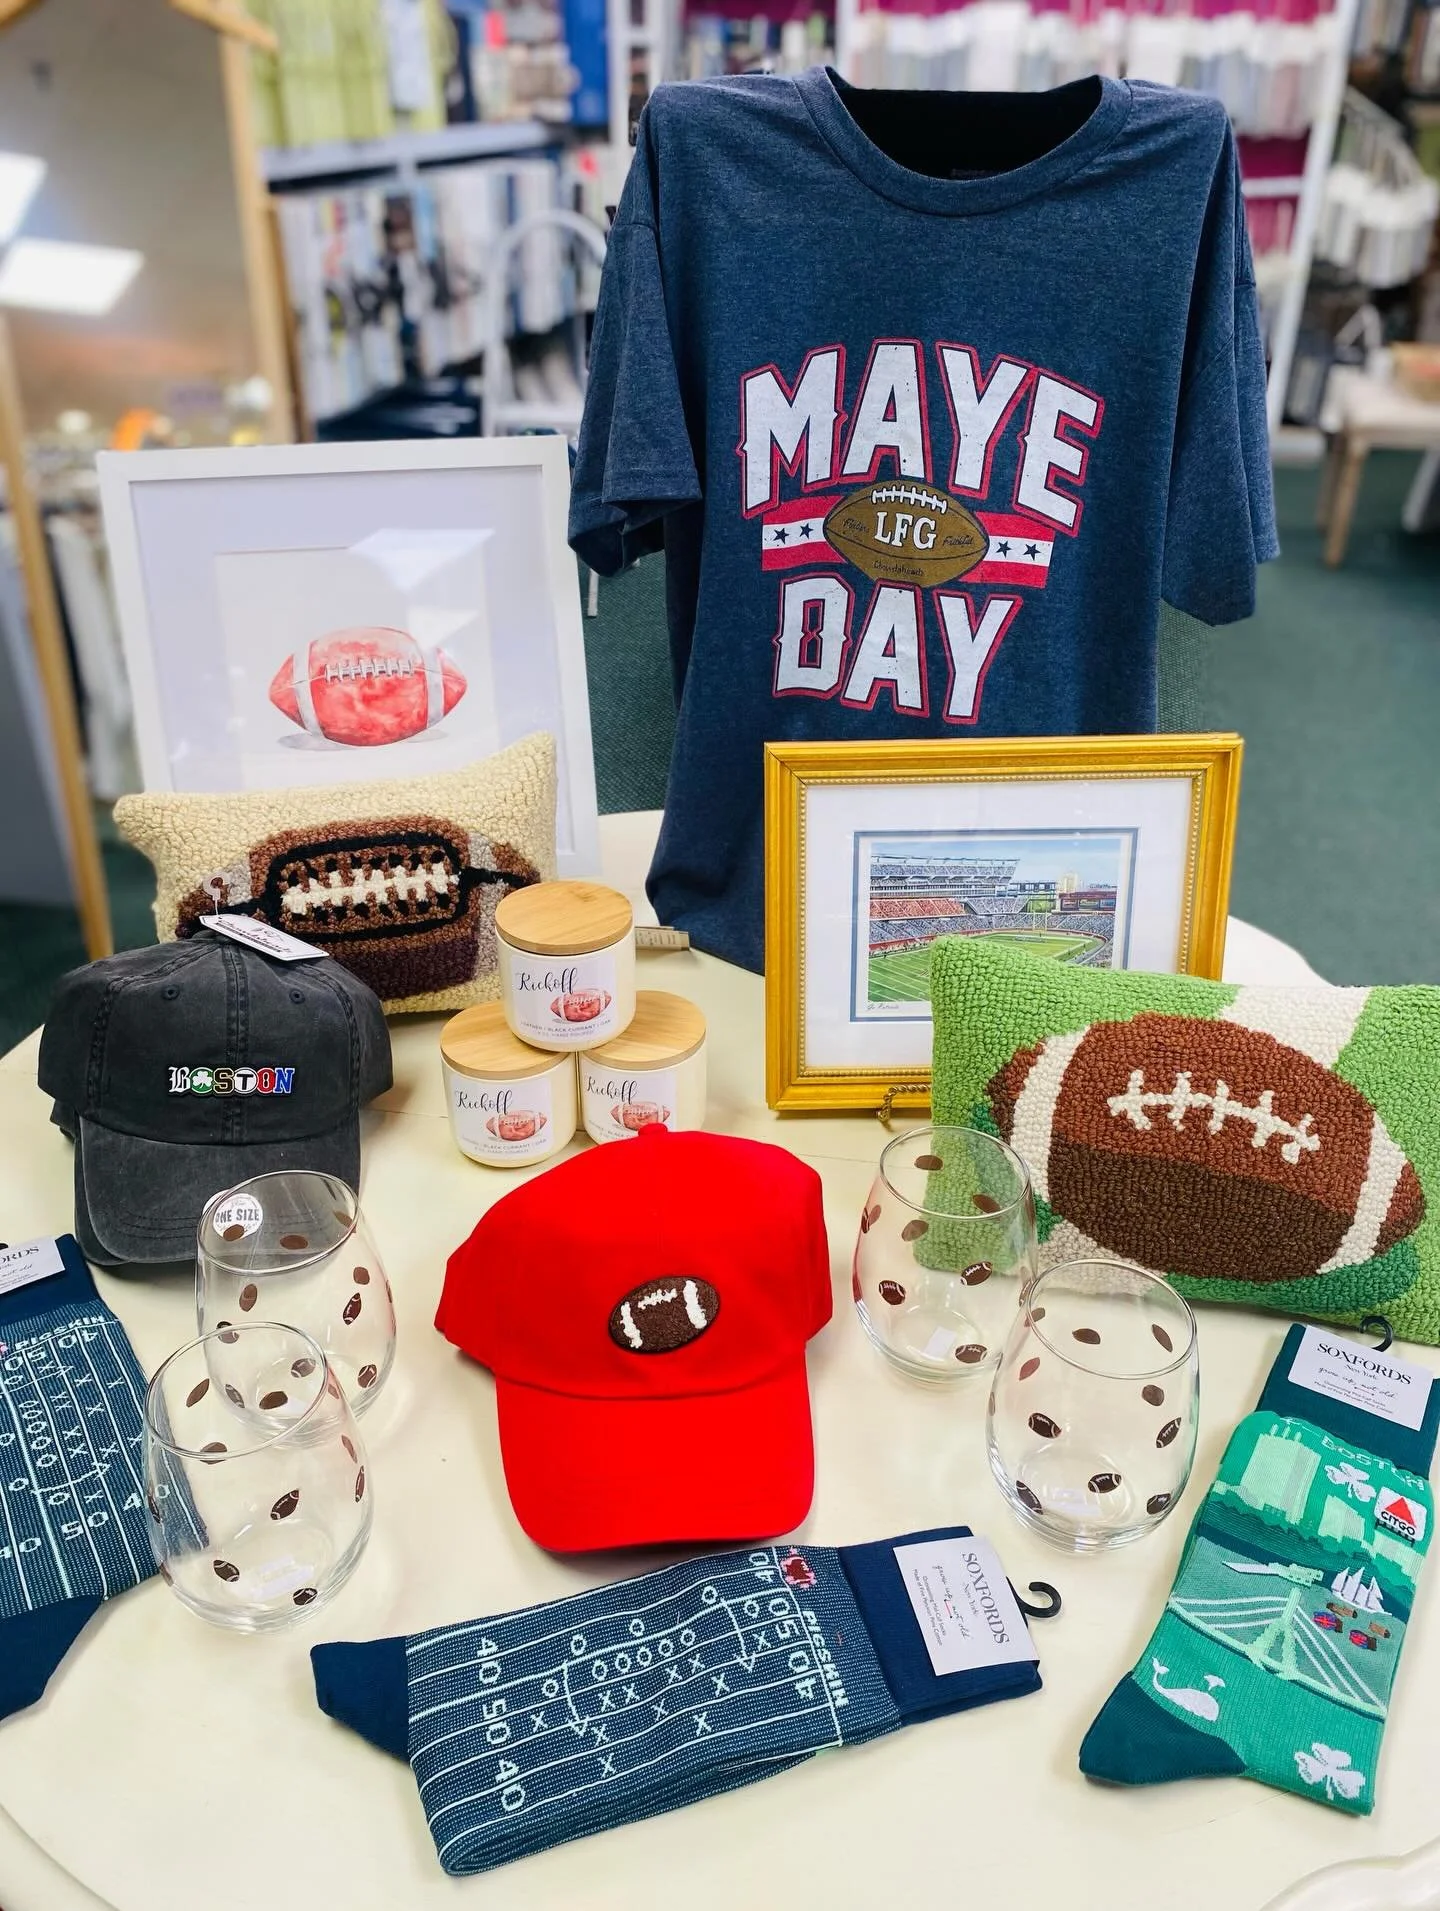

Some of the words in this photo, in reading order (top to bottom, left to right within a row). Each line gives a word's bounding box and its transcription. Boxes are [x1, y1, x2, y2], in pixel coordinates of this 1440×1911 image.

[736, 338, 1104, 537] MAYE
[873, 511, 937, 550] LFG
[772, 572, 1024, 724] DAY
[517, 967, 578, 995] Kickoff
[168, 1066, 295, 1094] BOSTON
[586, 1076, 637, 1105] Kickoff
[456, 1090, 512, 1115] Kickoff
[215, 1209, 232, 1223] ONE
[236, 1208, 260, 1221] SIZE
[15, 1316, 104, 1350] PIGSKIN
[1317, 1343, 1412, 1385] SOXFORDS
[1380, 1511, 1415, 1536] CITGO
[962, 1552, 1010, 1645] SOXFORDS
[477, 1637, 501, 1684] 40
[802, 1611, 849, 1707] PIGSKIN
[482, 1699, 510, 1745] 50
[495, 1758, 525, 1811] 40
